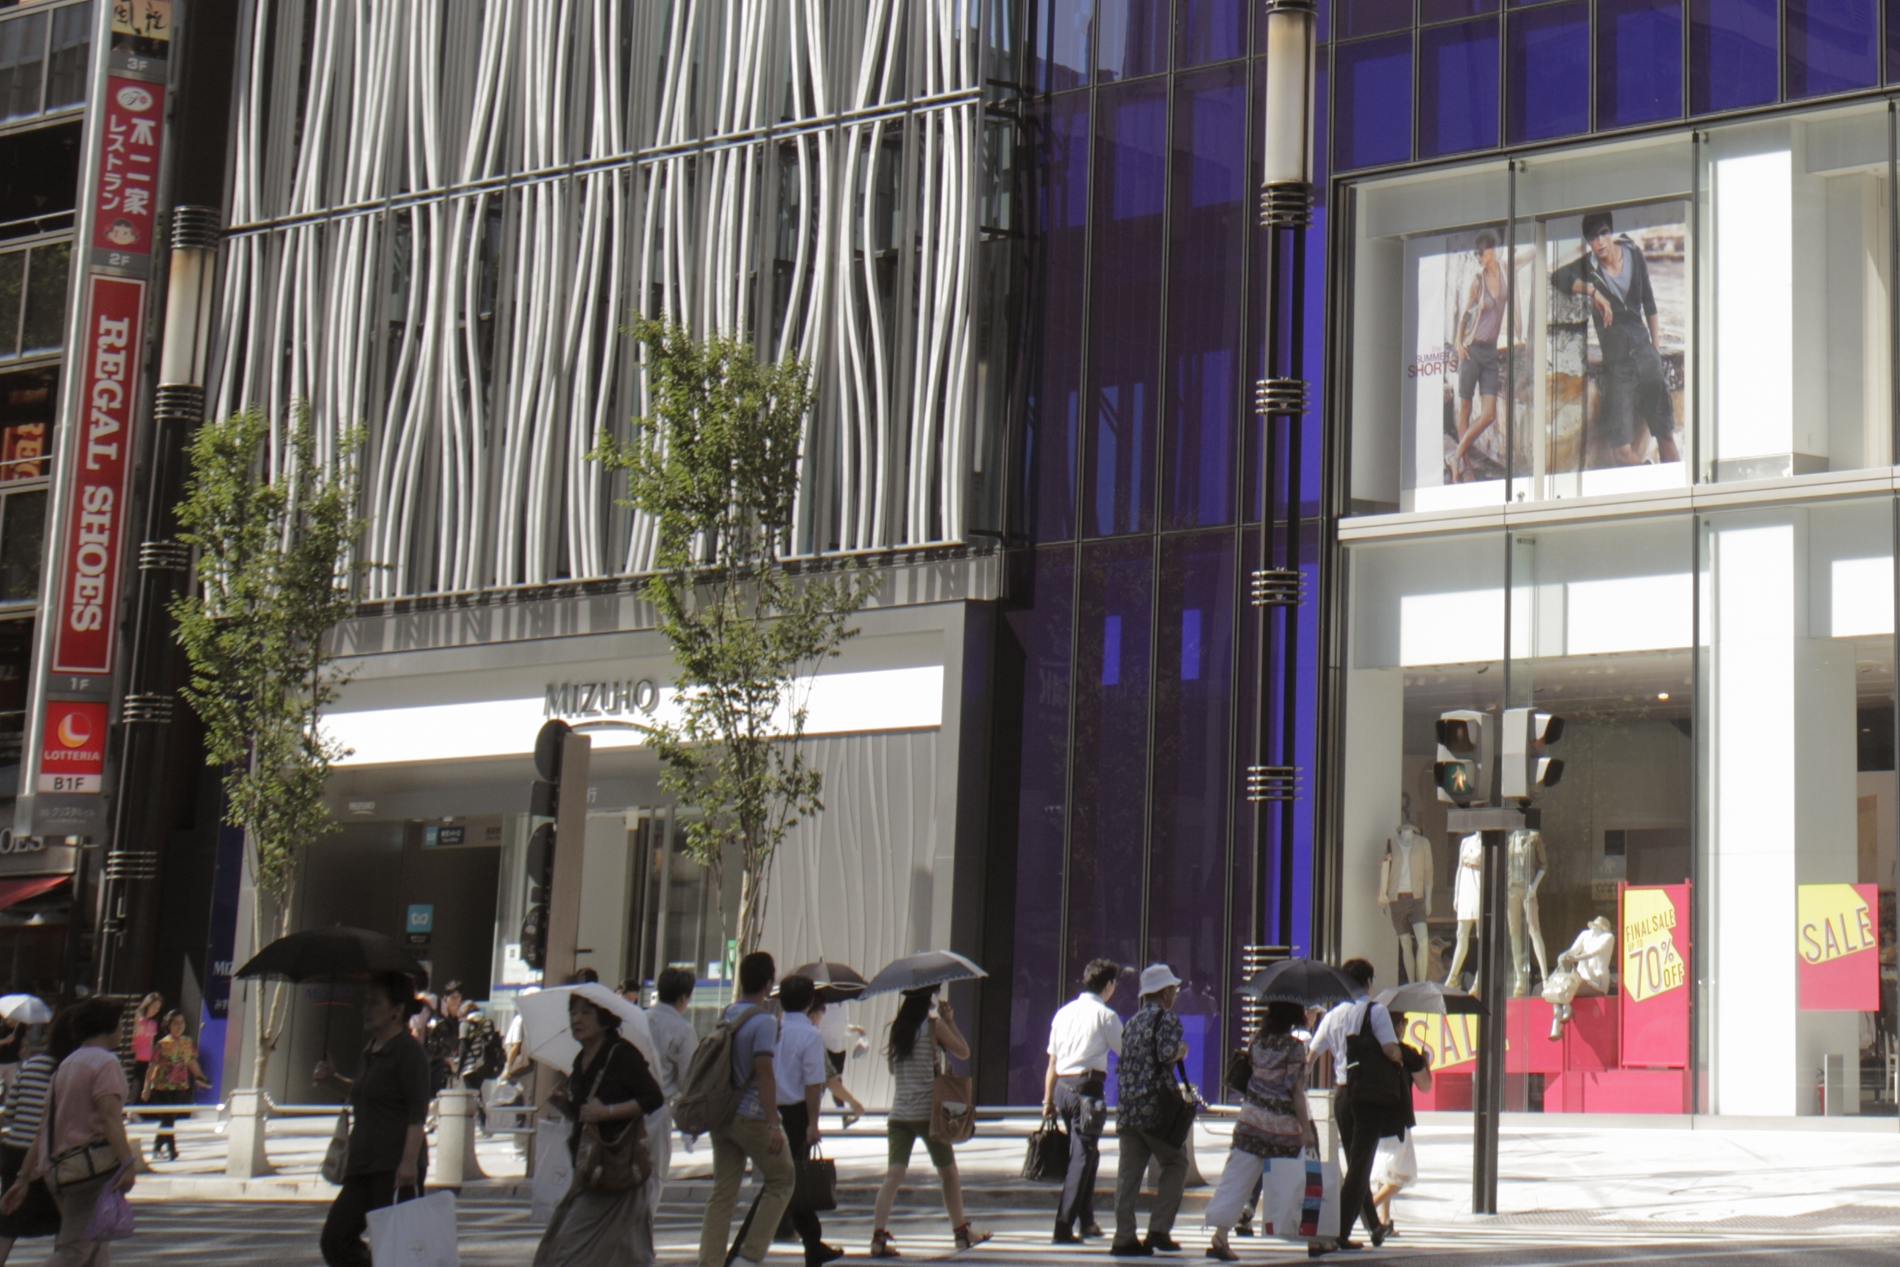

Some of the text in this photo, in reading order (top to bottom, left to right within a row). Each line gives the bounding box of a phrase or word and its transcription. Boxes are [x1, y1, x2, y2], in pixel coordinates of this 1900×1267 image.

[127, 58, 148, 71] 3F
[101, 114, 127, 210] レストラン
[123, 117, 156, 216] 不二家
[109, 253, 131, 266] 2F
[1407, 359, 1459, 379] SHORTS
[1415, 351, 1450, 364] SUMMER
[70, 315, 130, 633] REGAL SHOES
[70, 677, 90, 691] 1F
[544, 679, 660, 718] MIZUHO
[44, 750, 100, 762] LOTTERIA
[54, 776, 86, 791] B1F
[1625, 908, 1675, 942] FINAL SALE
[1802, 905, 1875, 962] SALE
[1629, 938, 1675, 1000] 70%
[1663, 963, 1684, 989] OFF
[1409, 1013, 1477, 1068] SAL
